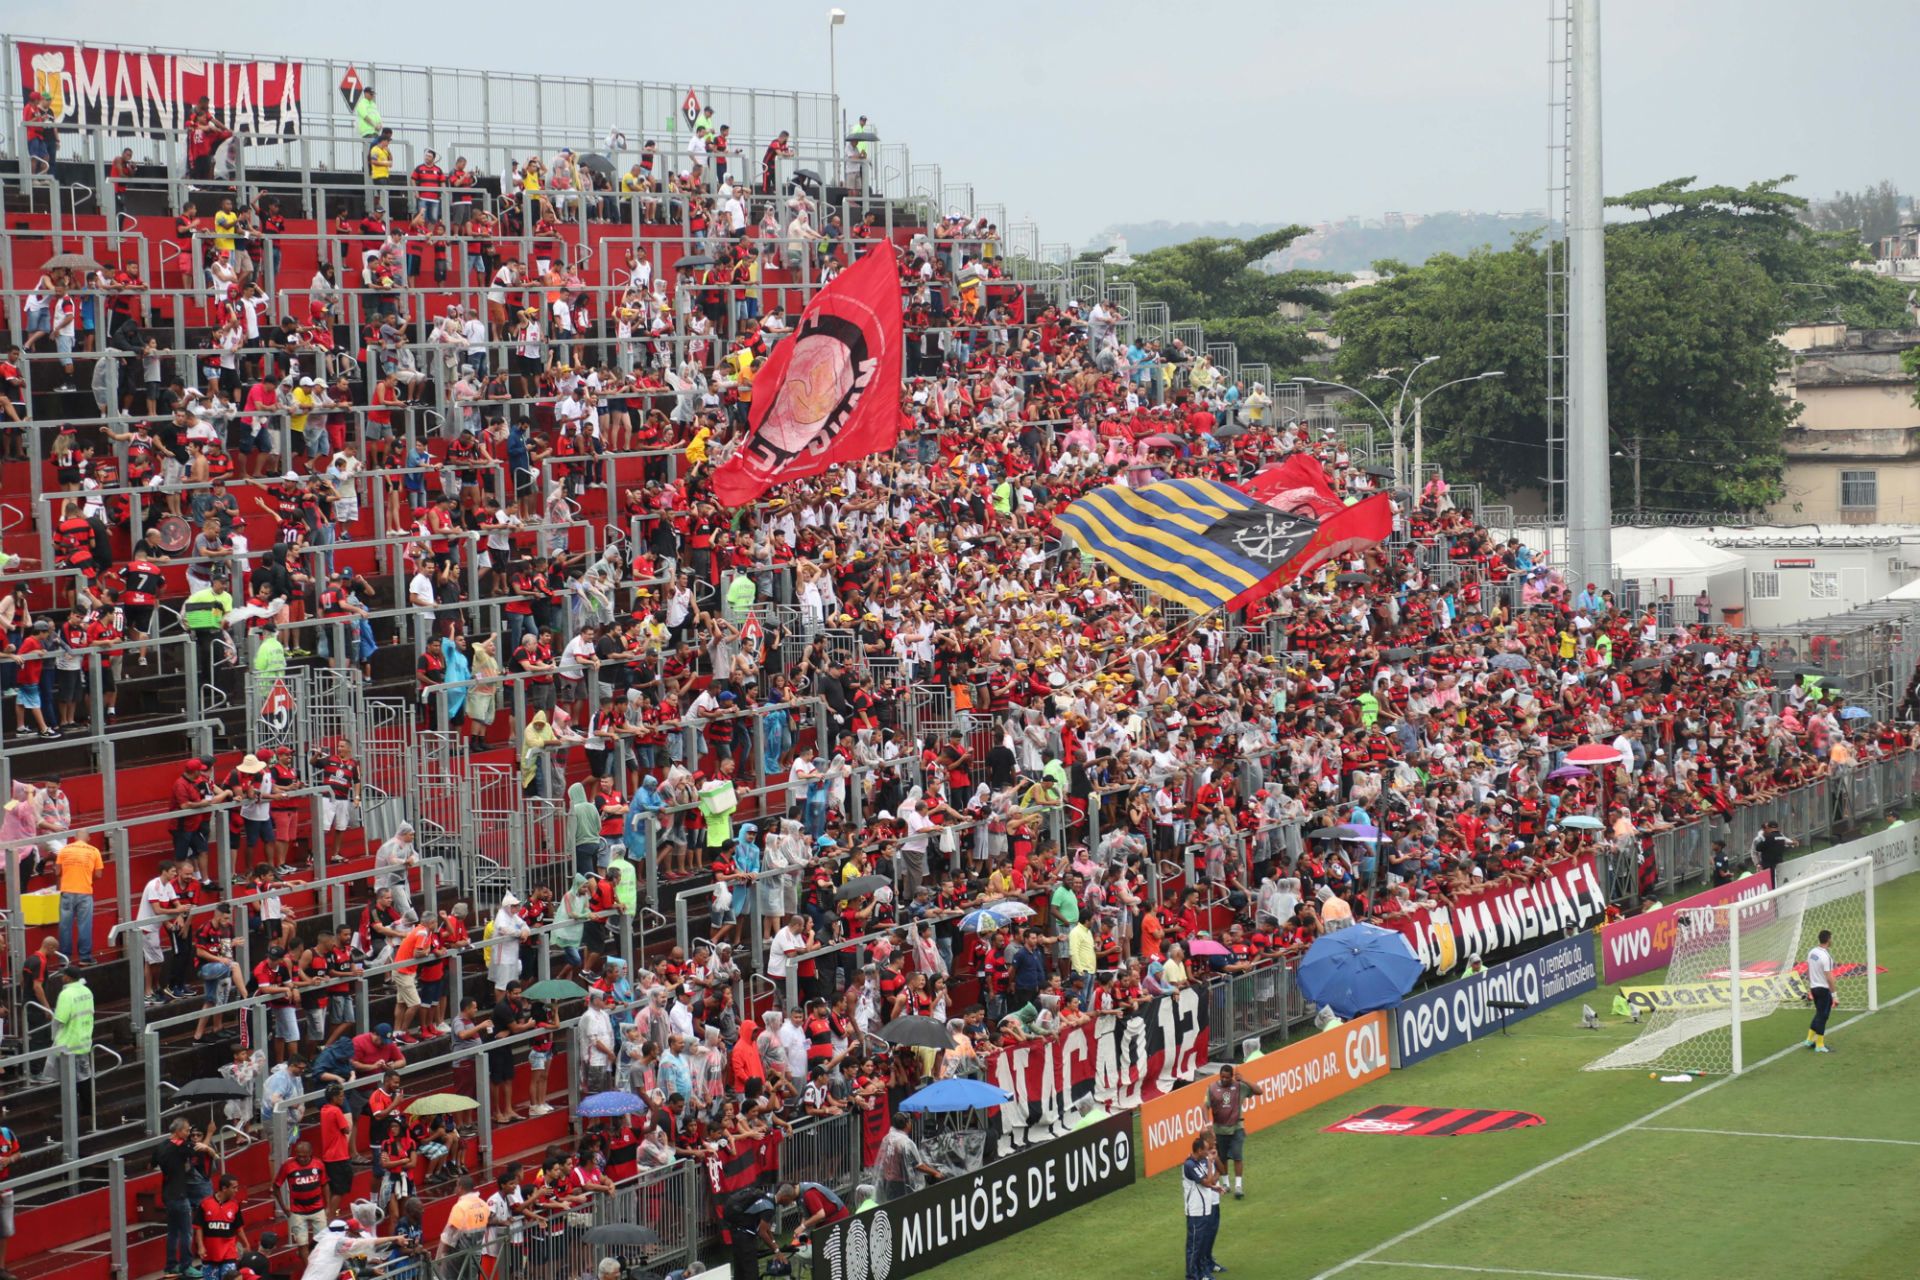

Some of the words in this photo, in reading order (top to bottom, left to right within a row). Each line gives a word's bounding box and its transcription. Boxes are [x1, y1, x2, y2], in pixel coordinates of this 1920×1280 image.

[347, 76, 357, 103] 7
[687, 97, 696, 121] 8
[283, 528, 297, 543] 10
[136, 573, 148, 590] 7
[273, 694, 288, 731] 5
[1456, 862, 1606, 959] MANGUAÇA
[1611, 927, 1650, 966] VIVO
[1652, 918, 1677, 952] 4G+
[1539, 957, 1546, 976] O
[1546, 947, 1572, 974] remédio
[1403, 997, 1449, 1057] neo
[1453, 962, 1539, 1042] química
[1345, 1021, 1387, 1080] GOL
[1257, 1066, 1302, 1105] TEMPOS
[1305, 1059, 1321, 1087] NO
[1323, 1052, 1340, 1078] AR.
[1149, 1117, 1183, 1151] NOVA
[823, 1210, 893, 1280] 100
[901, 1175, 1018, 1261] MILHÕES
[1028, 1158, 1056, 1209] DE
[1066, 1137, 1110, 1192] UNS
